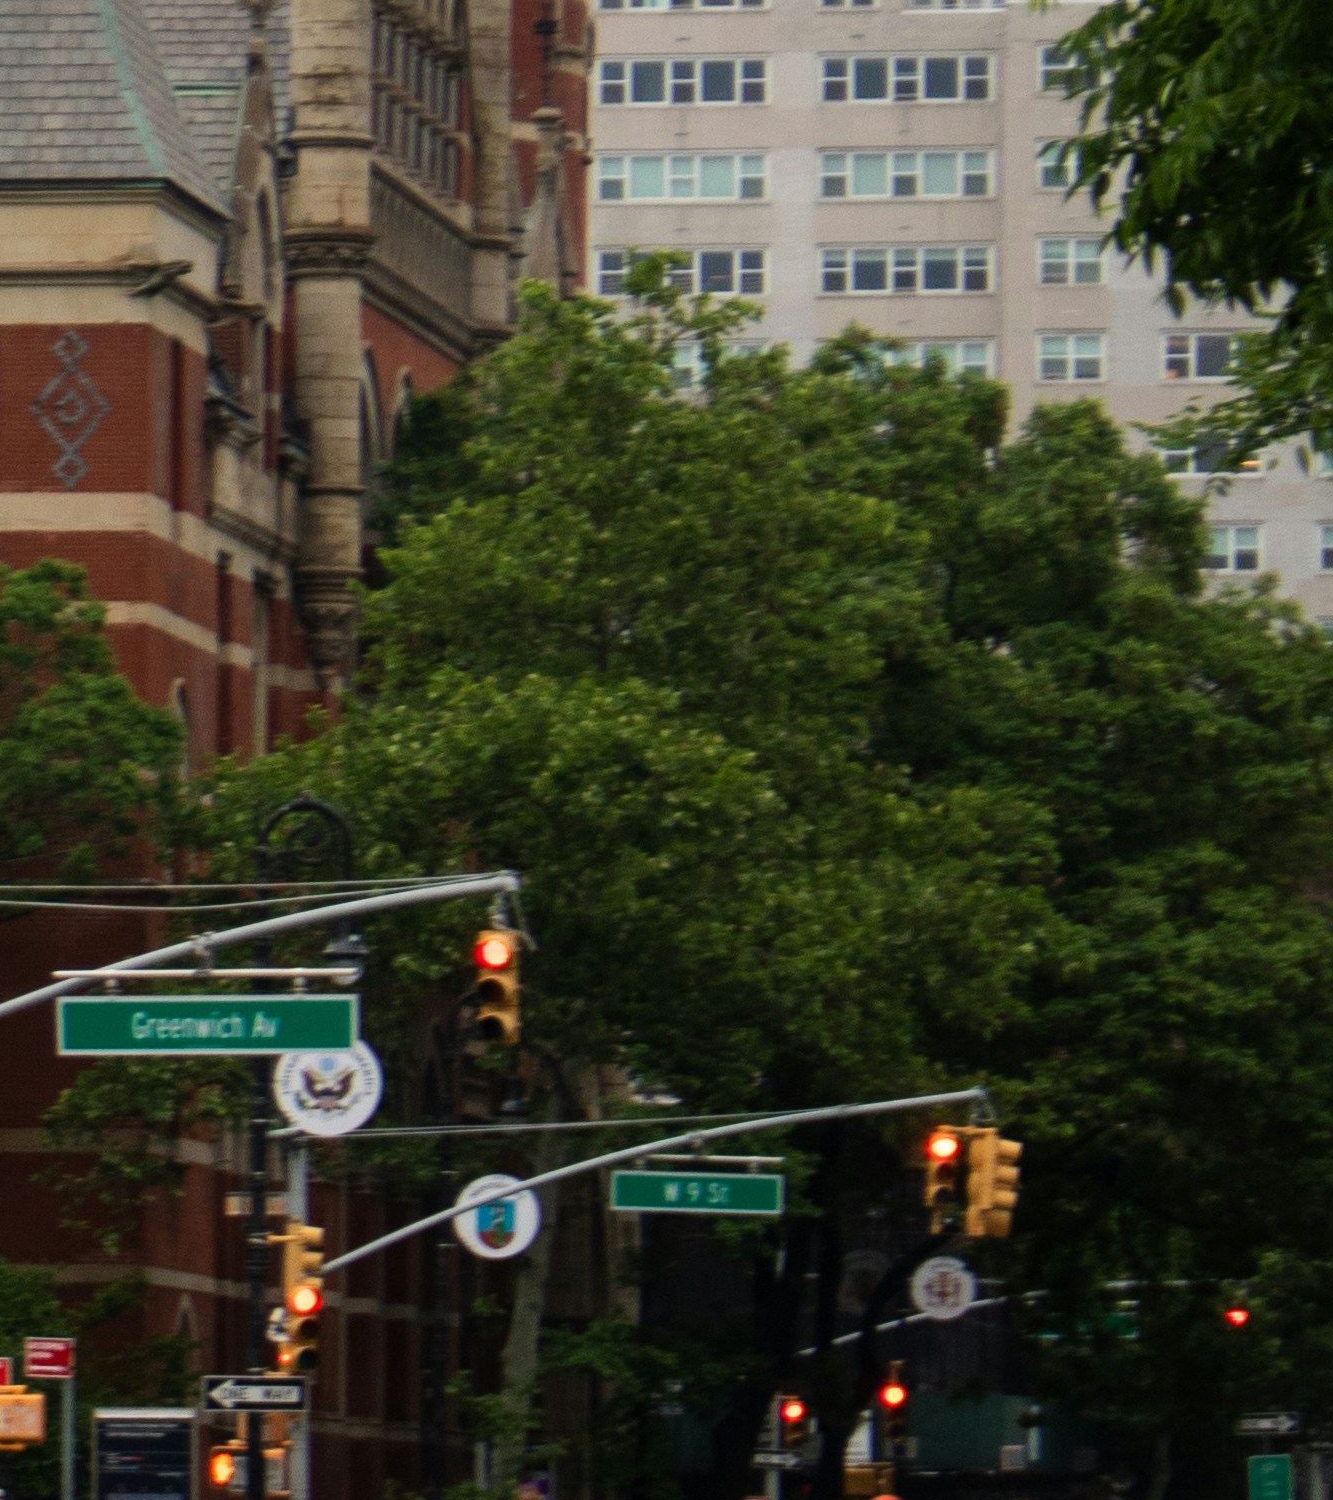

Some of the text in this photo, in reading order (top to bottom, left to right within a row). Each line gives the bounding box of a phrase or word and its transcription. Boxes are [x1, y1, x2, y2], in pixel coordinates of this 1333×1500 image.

[132, 1011, 281, 1039] Greenwich Av
[687, 1181, 700, 1202] 9
[708, 1182, 729, 1204] St
[221, 1386, 252, 1401] ONE
